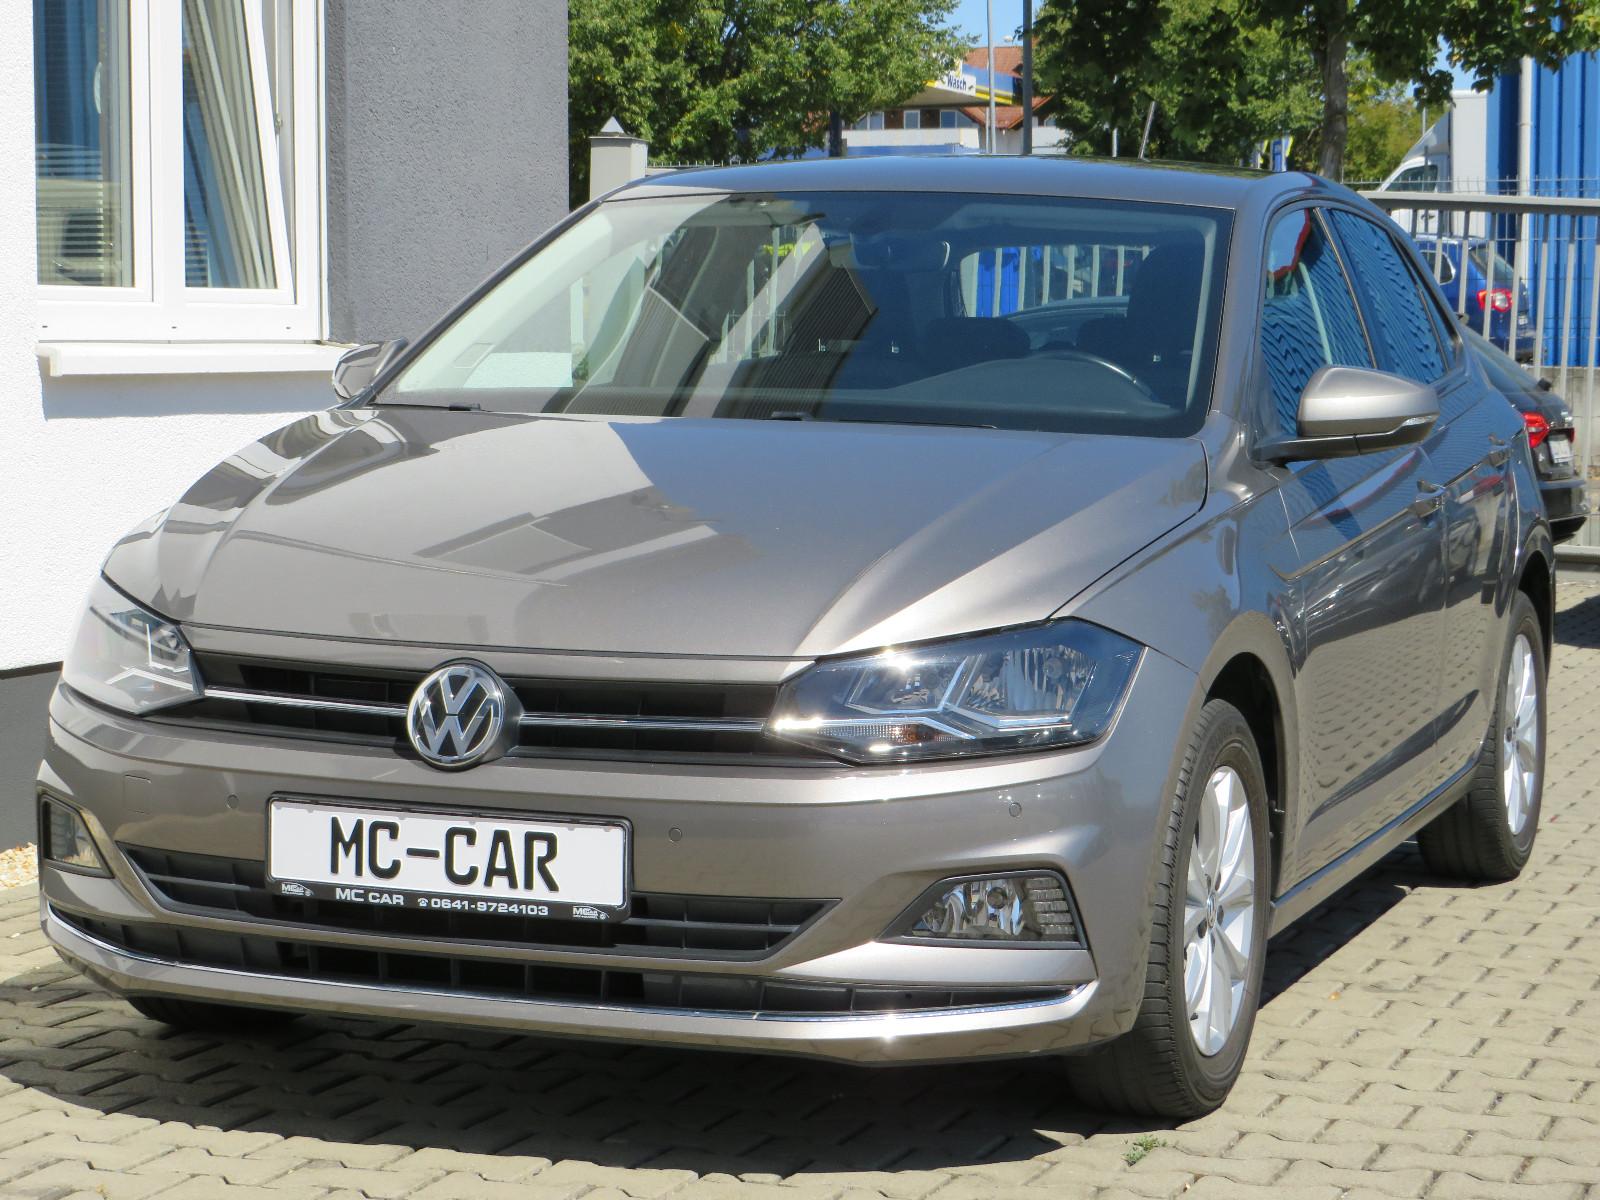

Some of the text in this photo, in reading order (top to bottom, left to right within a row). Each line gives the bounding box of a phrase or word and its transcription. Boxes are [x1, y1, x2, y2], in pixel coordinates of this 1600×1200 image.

[946, 74, 967, 91] Wasch
[410, 665, 500, 762] VW
[330, 816, 560, 892] MC-CAR
[335, 887, 549, 916] MC CAR 0641-9724103
